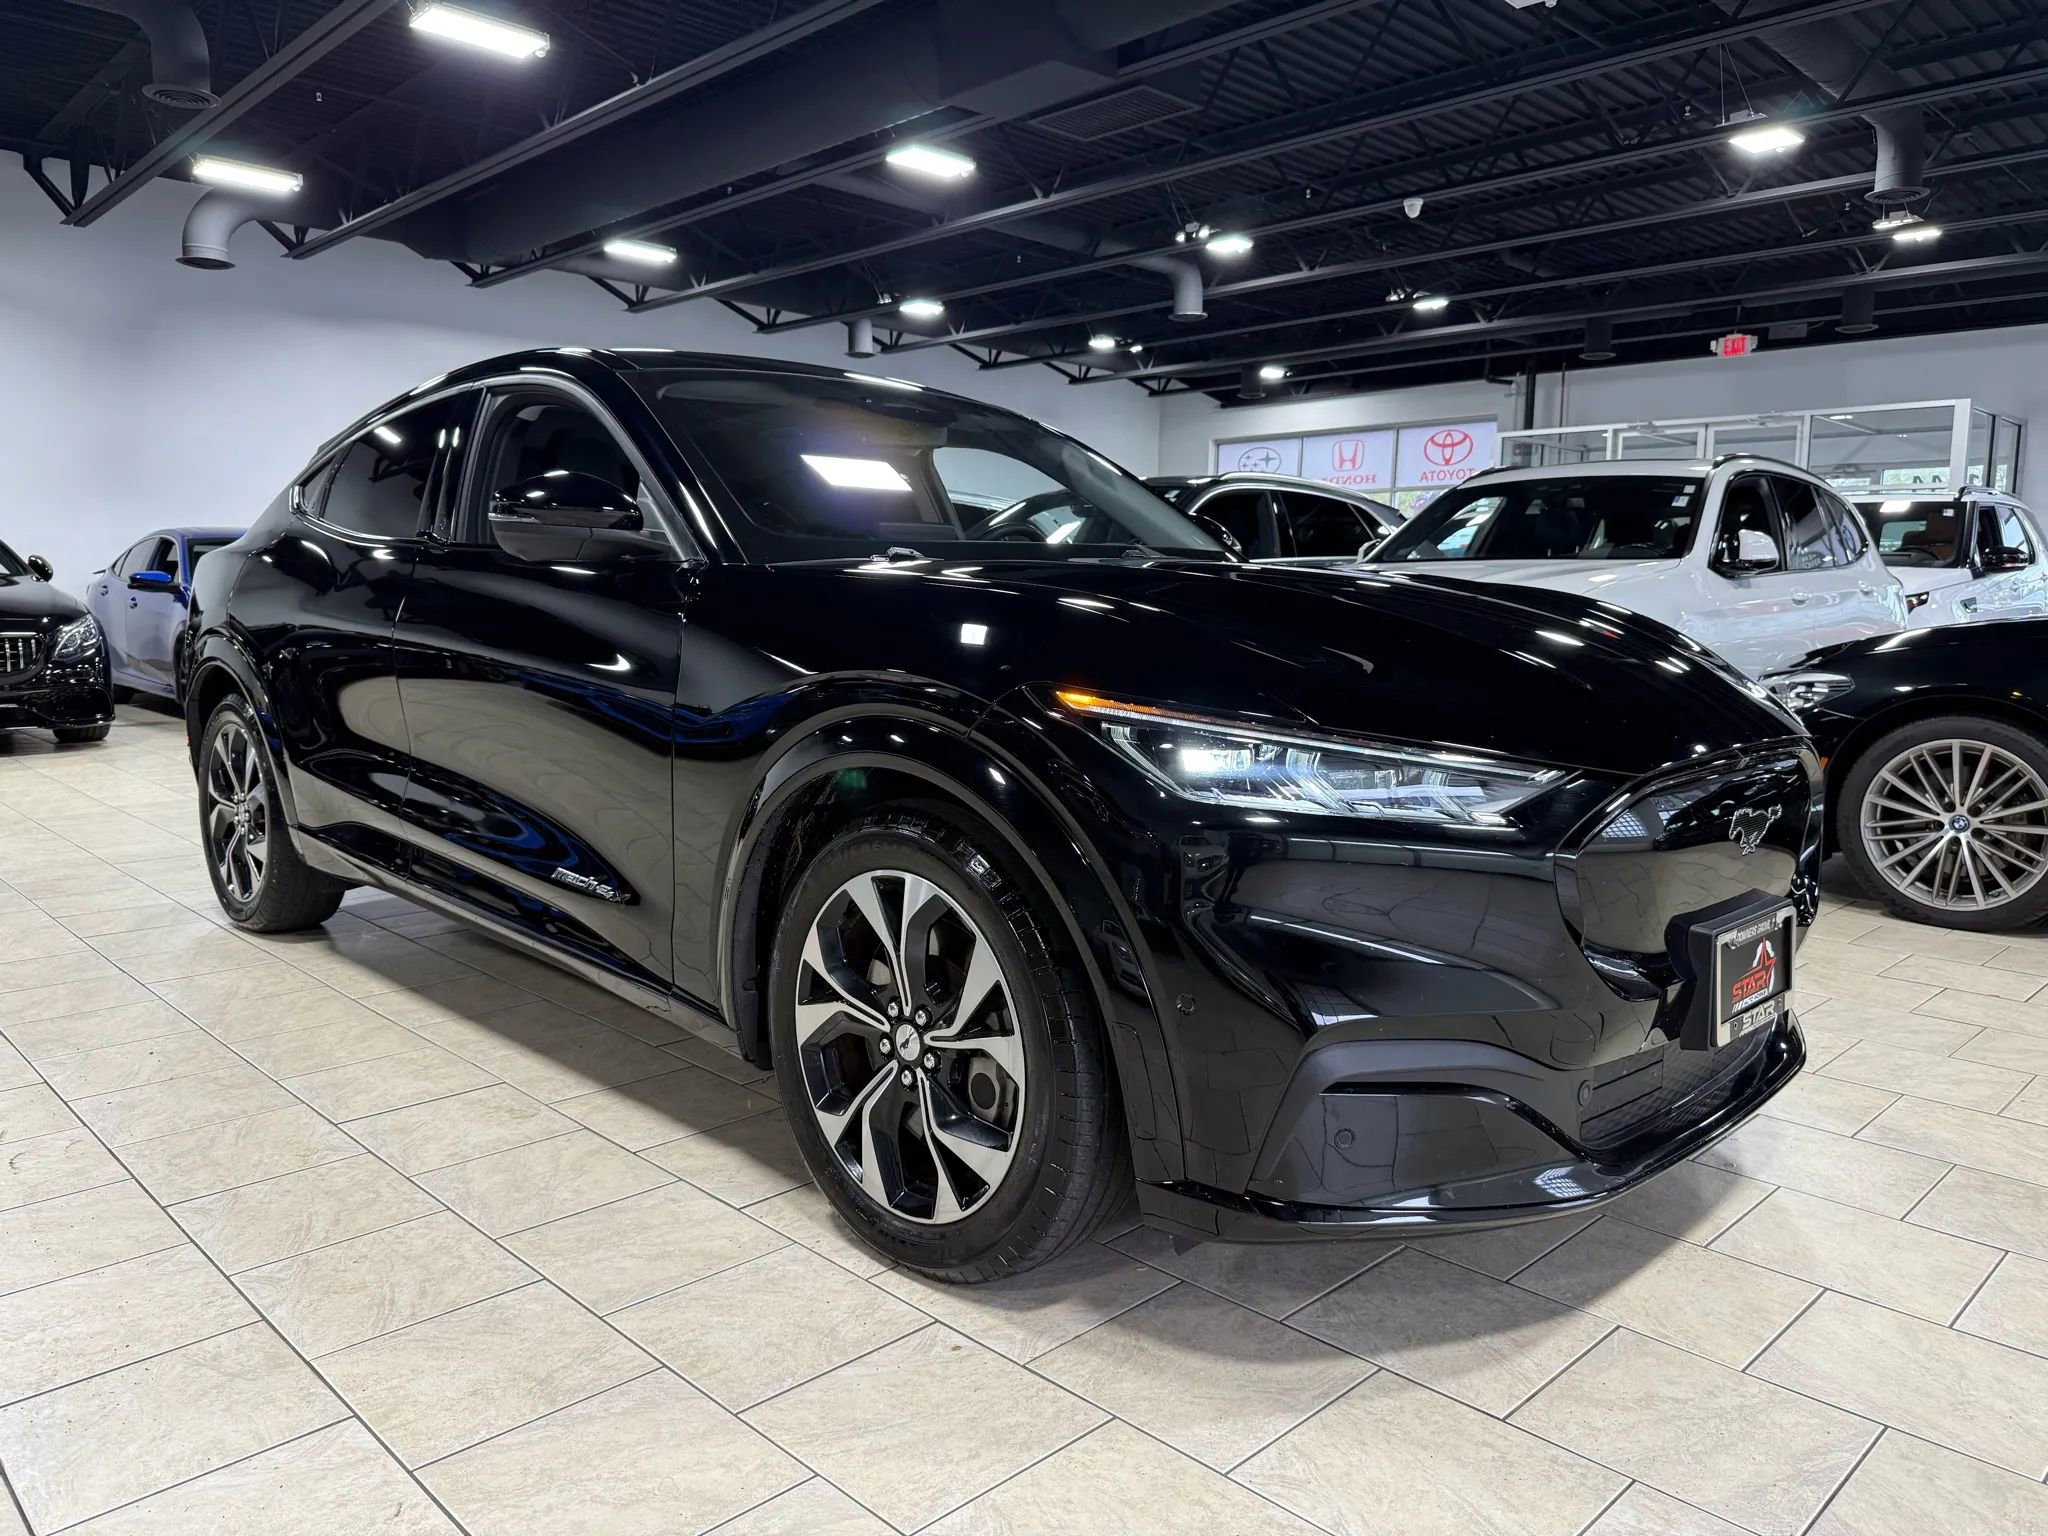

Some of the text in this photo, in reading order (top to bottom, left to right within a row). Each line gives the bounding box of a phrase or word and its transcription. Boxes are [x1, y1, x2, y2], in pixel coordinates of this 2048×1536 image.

[1723, 336, 1747, 357] EXIT
[1732, 970, 1767, 1004] STAR
[1742, 1000, 1775, 1030] STAR
